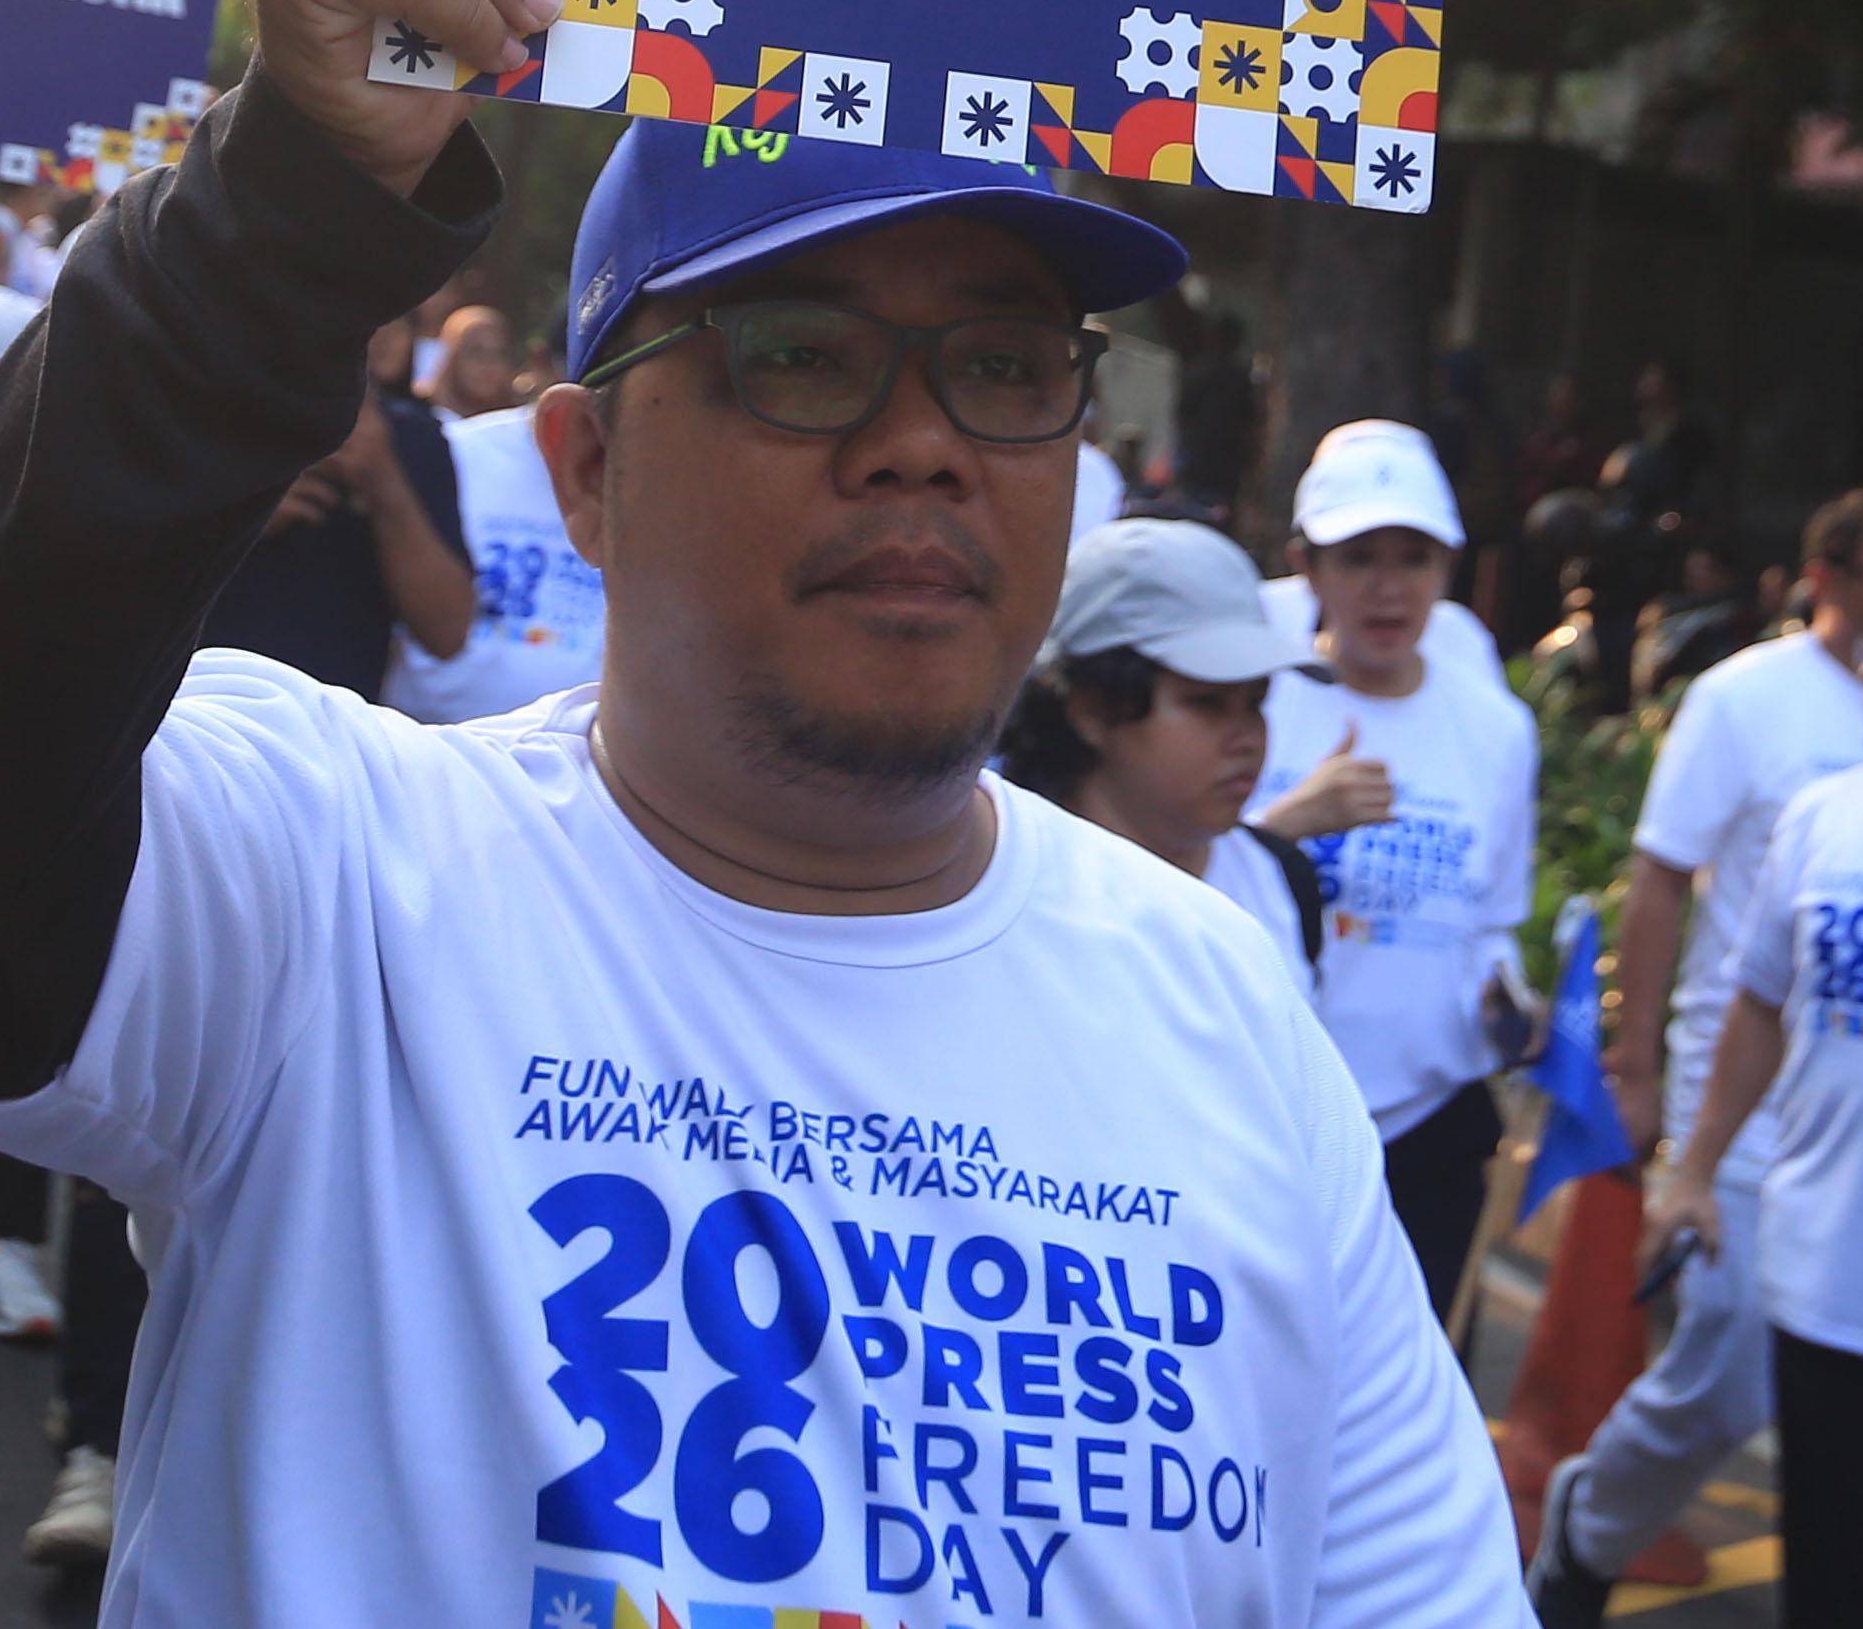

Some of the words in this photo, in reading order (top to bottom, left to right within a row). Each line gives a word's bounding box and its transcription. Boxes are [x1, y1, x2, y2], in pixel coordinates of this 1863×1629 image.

[520, 1054, 632, 1099] FUN
[769, 1100, 1002, 1164] BERSAMA
[830, 1155, 854, 1192] &
[870, 1155, 1181, 1228] MASYARAKAT
[525, 1172, 832, 1382] 20
[831, 1220, 1225, 1348] WORLD
[841, 1313, 1196, 1434] PRESS
[535, 1363, 826, 1585] 26
[864, 1500, 1072, 1620] DAY
